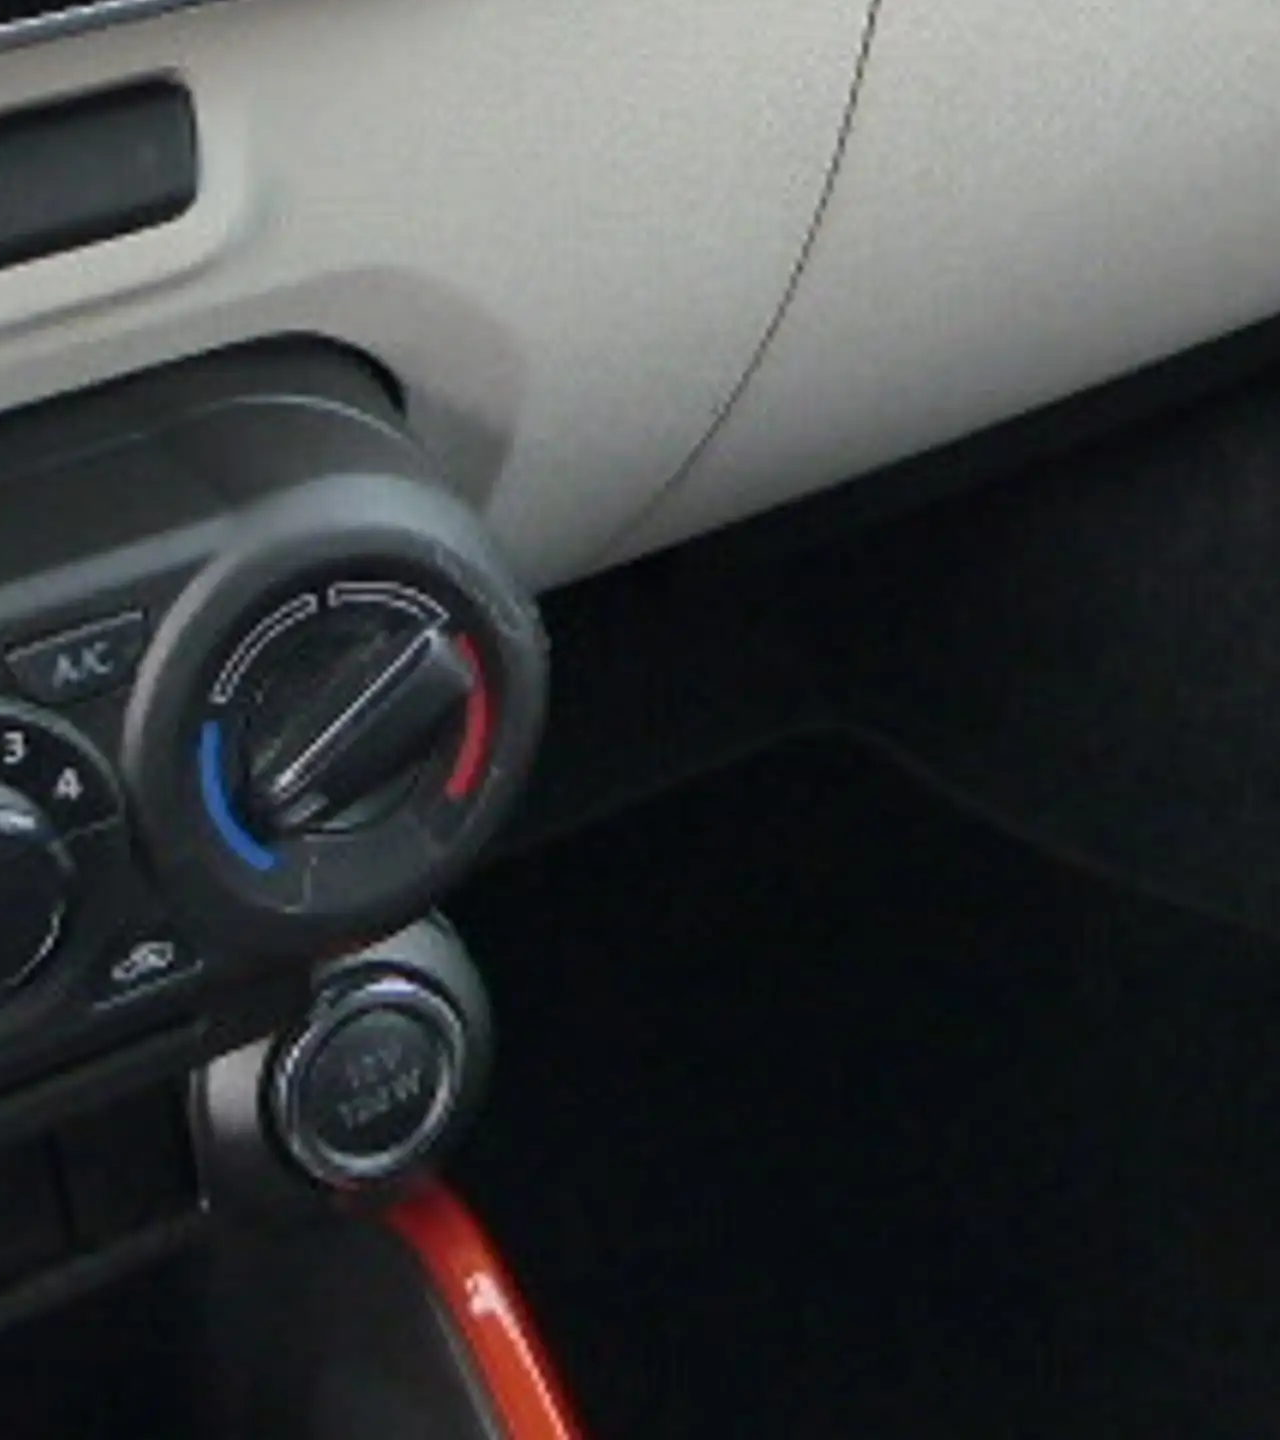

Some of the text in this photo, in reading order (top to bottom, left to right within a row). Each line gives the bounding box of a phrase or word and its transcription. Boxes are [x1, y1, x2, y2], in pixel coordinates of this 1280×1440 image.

[52, 641, 115, 689] A/C
[2, 730, 26, 765] 3
[55, 767, 84, 801] 4
